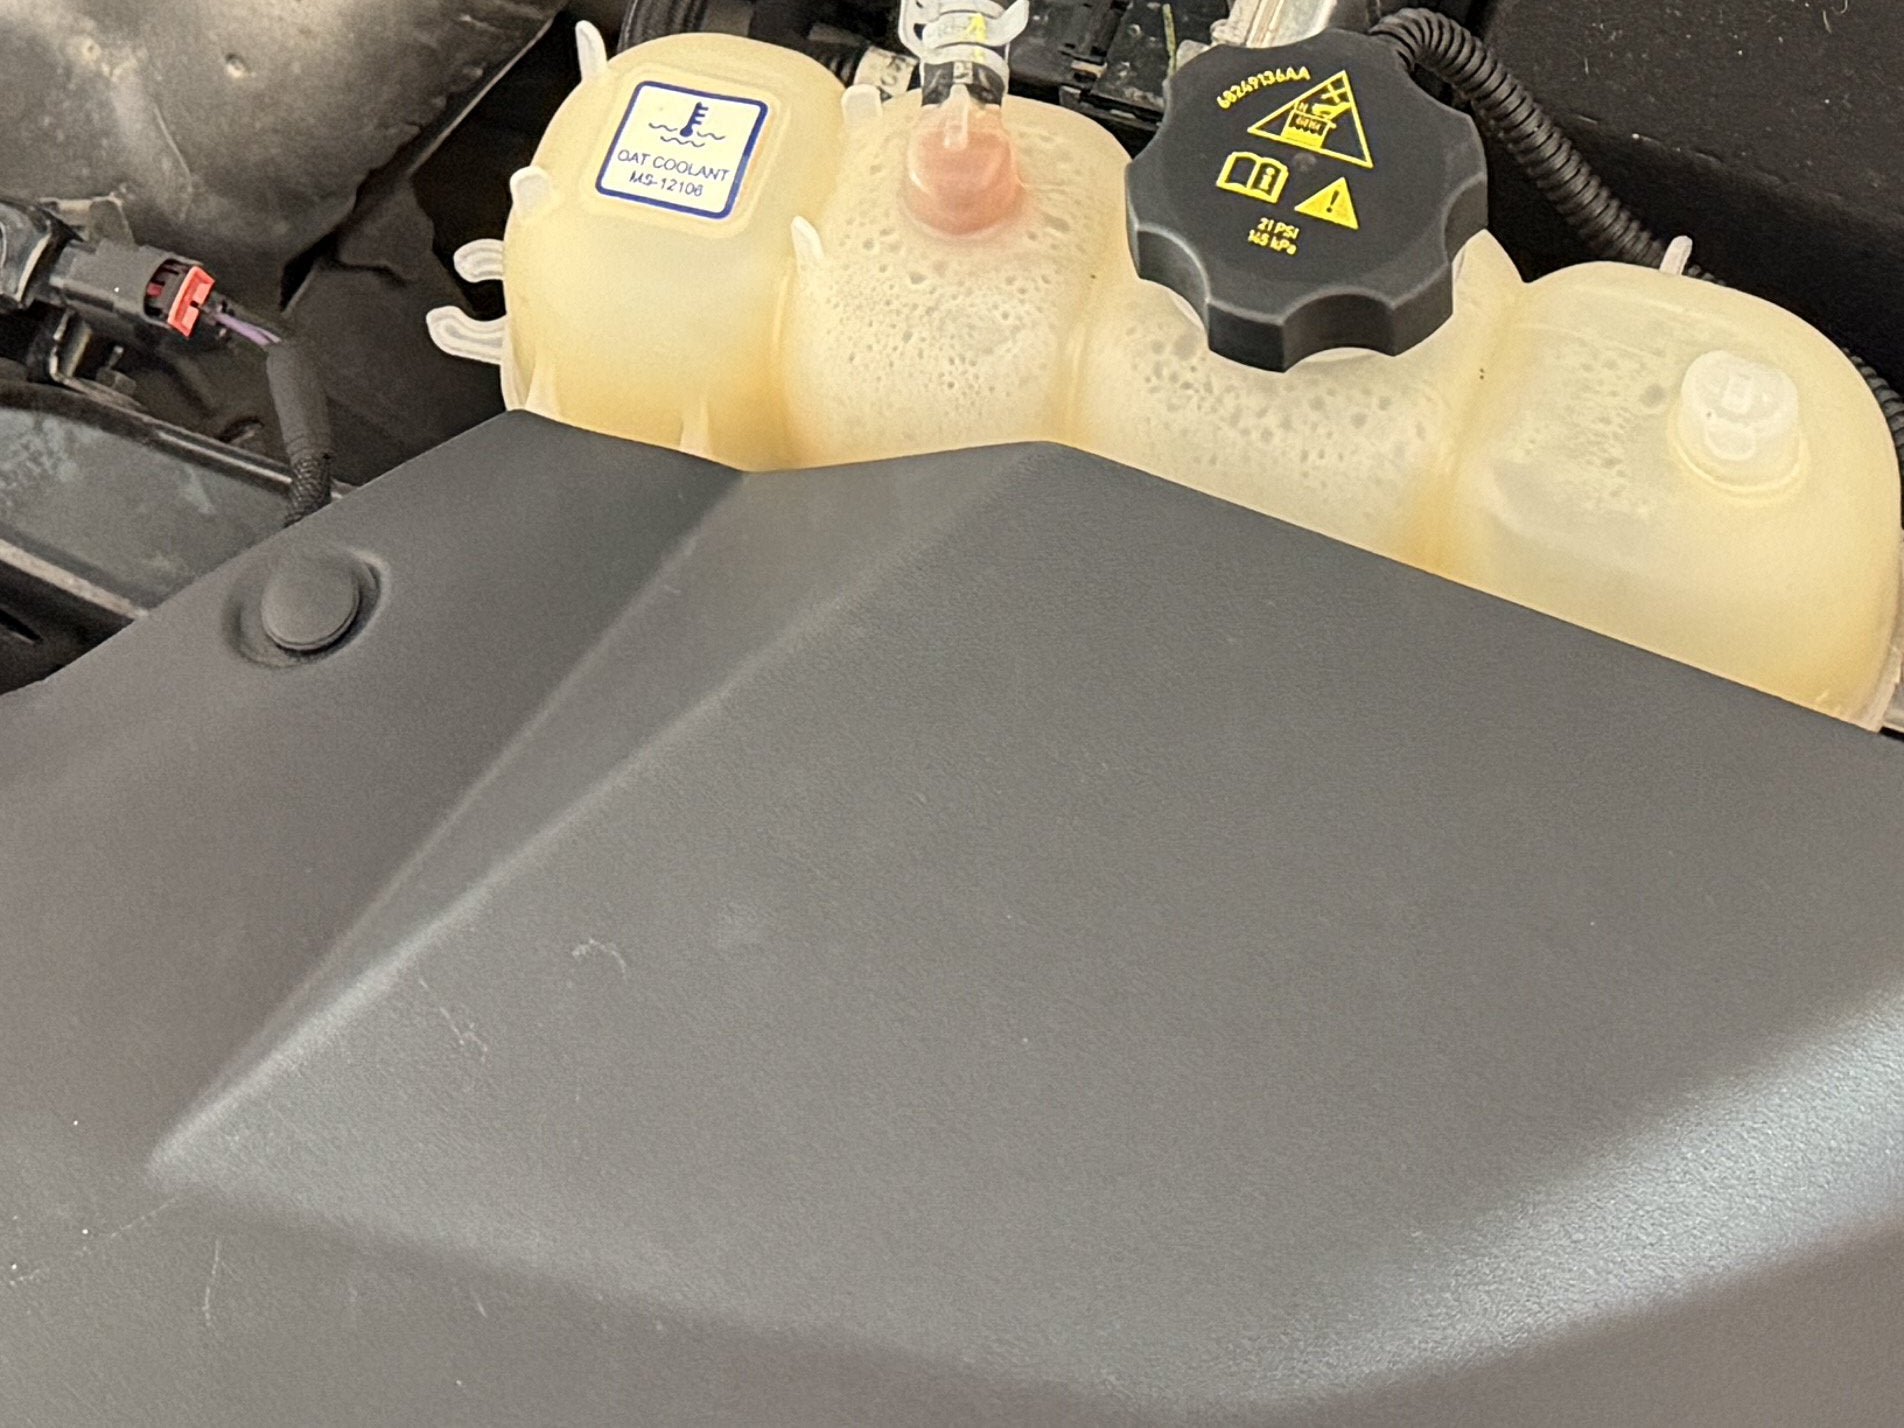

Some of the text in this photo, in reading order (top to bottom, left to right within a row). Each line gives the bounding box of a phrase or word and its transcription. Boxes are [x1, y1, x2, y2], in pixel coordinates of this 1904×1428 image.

[617, 149, 730, 181] OAT COOLANT
[1257, 217, 1300, 240] 21 PSI
[1270, 236, 1297, 255] kPa
